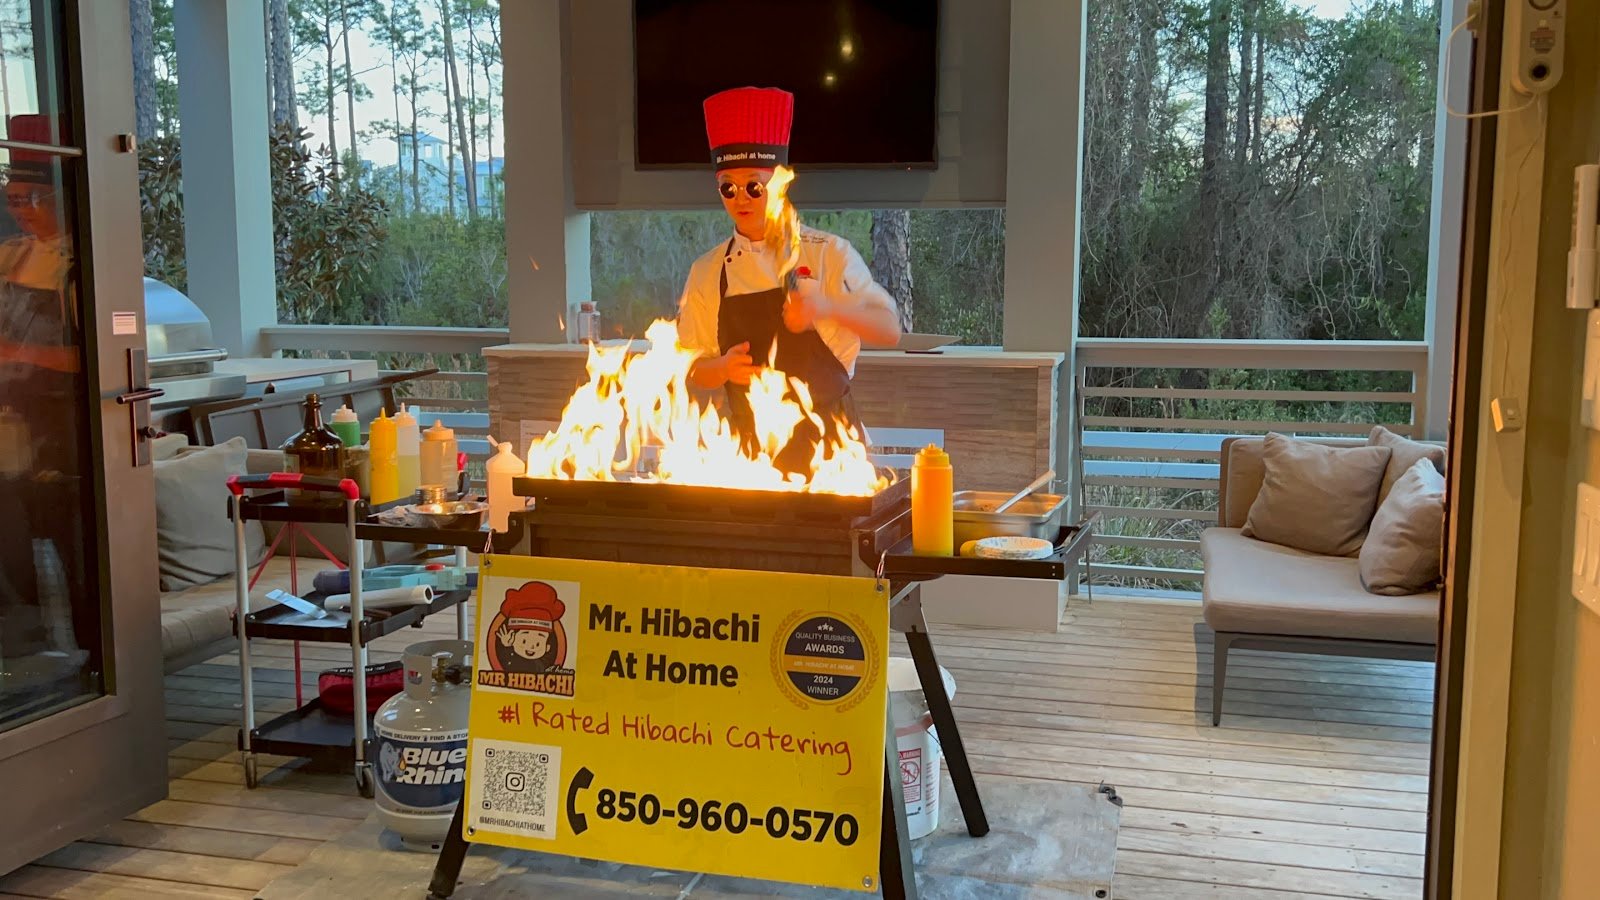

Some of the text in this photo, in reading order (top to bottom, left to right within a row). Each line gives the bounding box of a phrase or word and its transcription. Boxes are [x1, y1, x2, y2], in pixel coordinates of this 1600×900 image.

[724, 152, 748, 162] Hibachi
[749, 152, 756, 160] at
[757, 151, 776, 160] home
[588, 603, 760, 643] Mr. Hibachi
[795, 632, 856, 643] QUALITY BUSINESS
[805, 642, 845, 654] AWARDS
[602, 649, 739, 688] At Home
[479, 671, 575, 696] MR HIBACHI
[813, 675, 833, 684] 2024
[807, 685, 839, 696] WINNER
[531, 701, 610, 736] Rated
[622, 713, 713, 746] Hibachi
[725, 725, 853, 777] Catering
[403, 747, 467, 766] Blue
[596, 788, 859, 847] 850-960-0570
